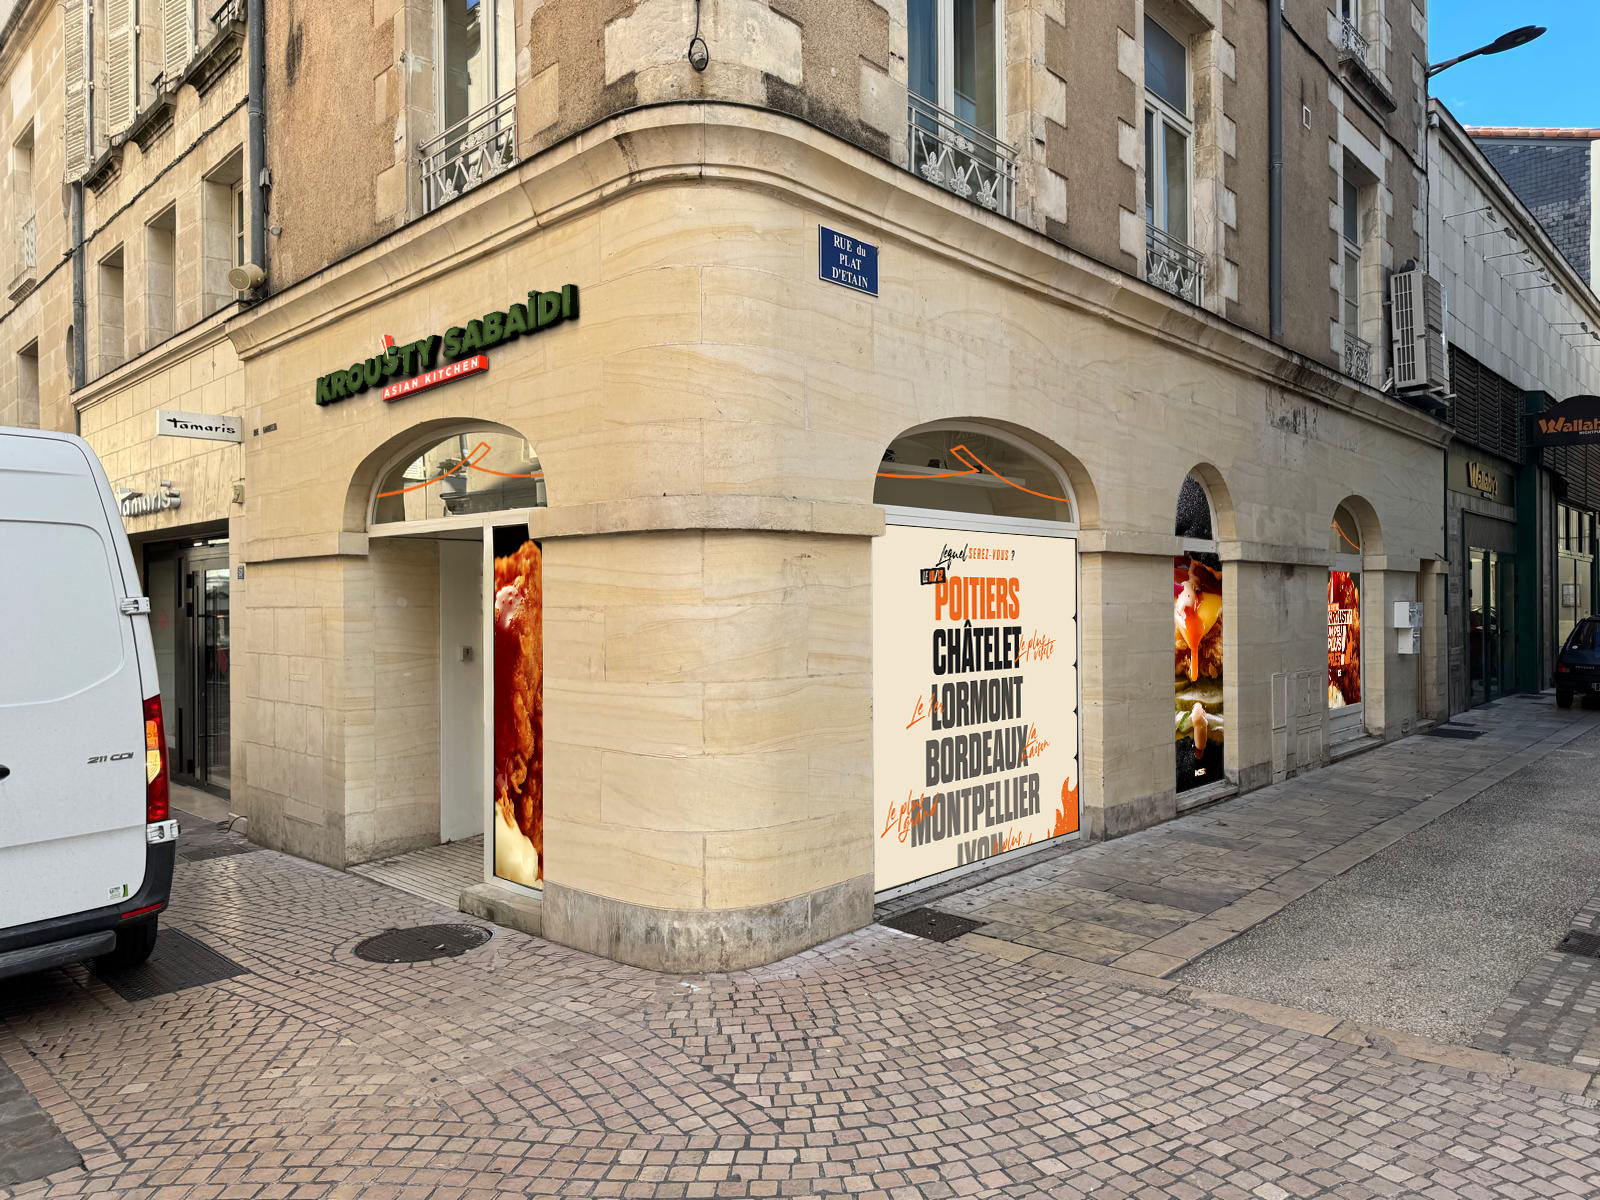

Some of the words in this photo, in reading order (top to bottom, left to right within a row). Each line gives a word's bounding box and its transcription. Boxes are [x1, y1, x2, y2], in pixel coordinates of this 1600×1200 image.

[833, 234, 853, 252] RUE
[856, 244, 866, 257] du
[839, 253, 862, 271] PLAT
[831, 266, 868, 289] D'ETAIN
[315, 335, 442, 406] KROUSTY
[443, 284, 579, 359] SABAÏDI
[383, 378, 418, 399] ASIAN
[424, 357, 479, 384] KITCHEN
[968, 547, 1009, 561] SEREZ-VOUS
[935, 575, 1021, 621] POITIERS
[932, 619, 1023, 676] CHÂTELET
[906, 695, 926, 730] Le
[931, 675, 1024, 731] LORMONT
[87, 755, 107, 764] 211
[110, 751, 134, 761] CDI
[925, 724, 1029, 788] BORDEAUX
[880, 801, 899, 839] Le
[911, 772, 1041, 848] MONTPELLIER
